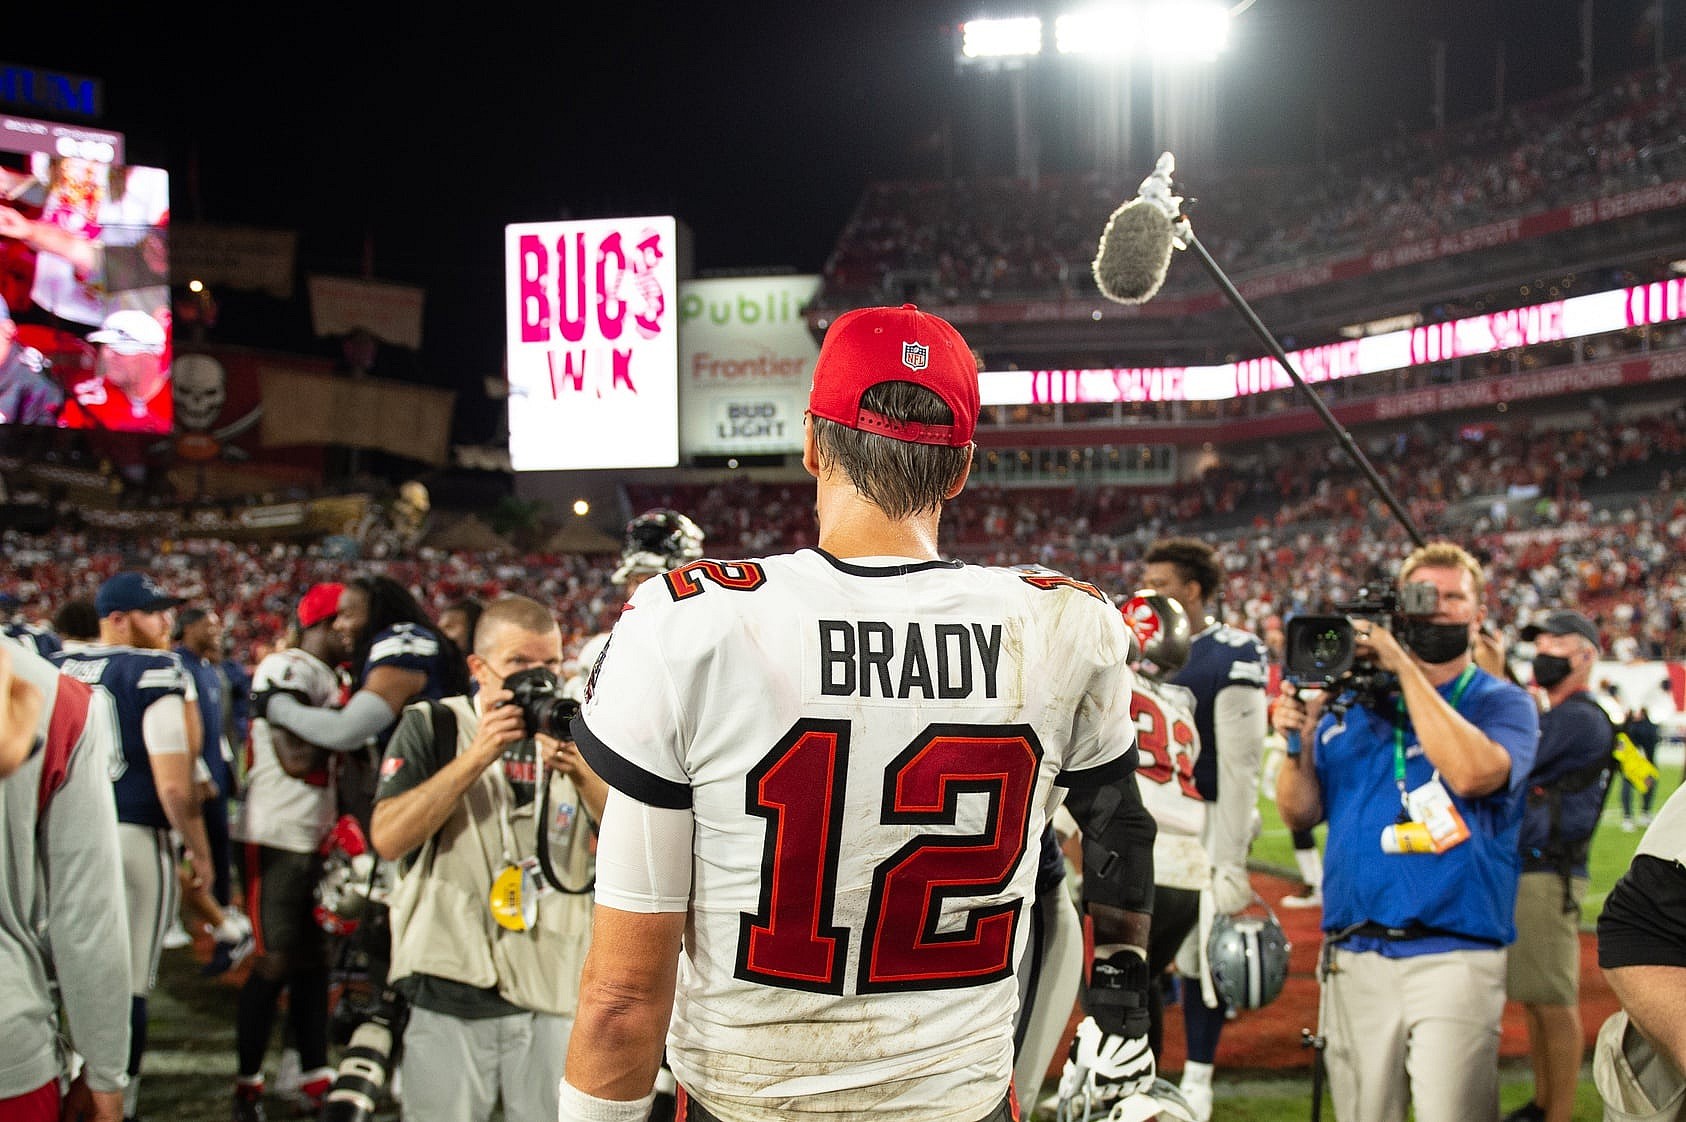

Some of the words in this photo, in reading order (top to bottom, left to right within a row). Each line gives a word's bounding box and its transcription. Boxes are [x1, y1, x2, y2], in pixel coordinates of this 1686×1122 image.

[519, 228, 665, 342] BUCS
[680, 292, 808, 325] Publi
[691, 351, 806, 380] Frontier
[907, 353, 924, 366] NFL
[728, 402, 776, 419] BUD
[717, 423, 785, 439] LIGHT
[818, 619, 1003, 700] BRADY
[733, 717, 1045, 997] 12
